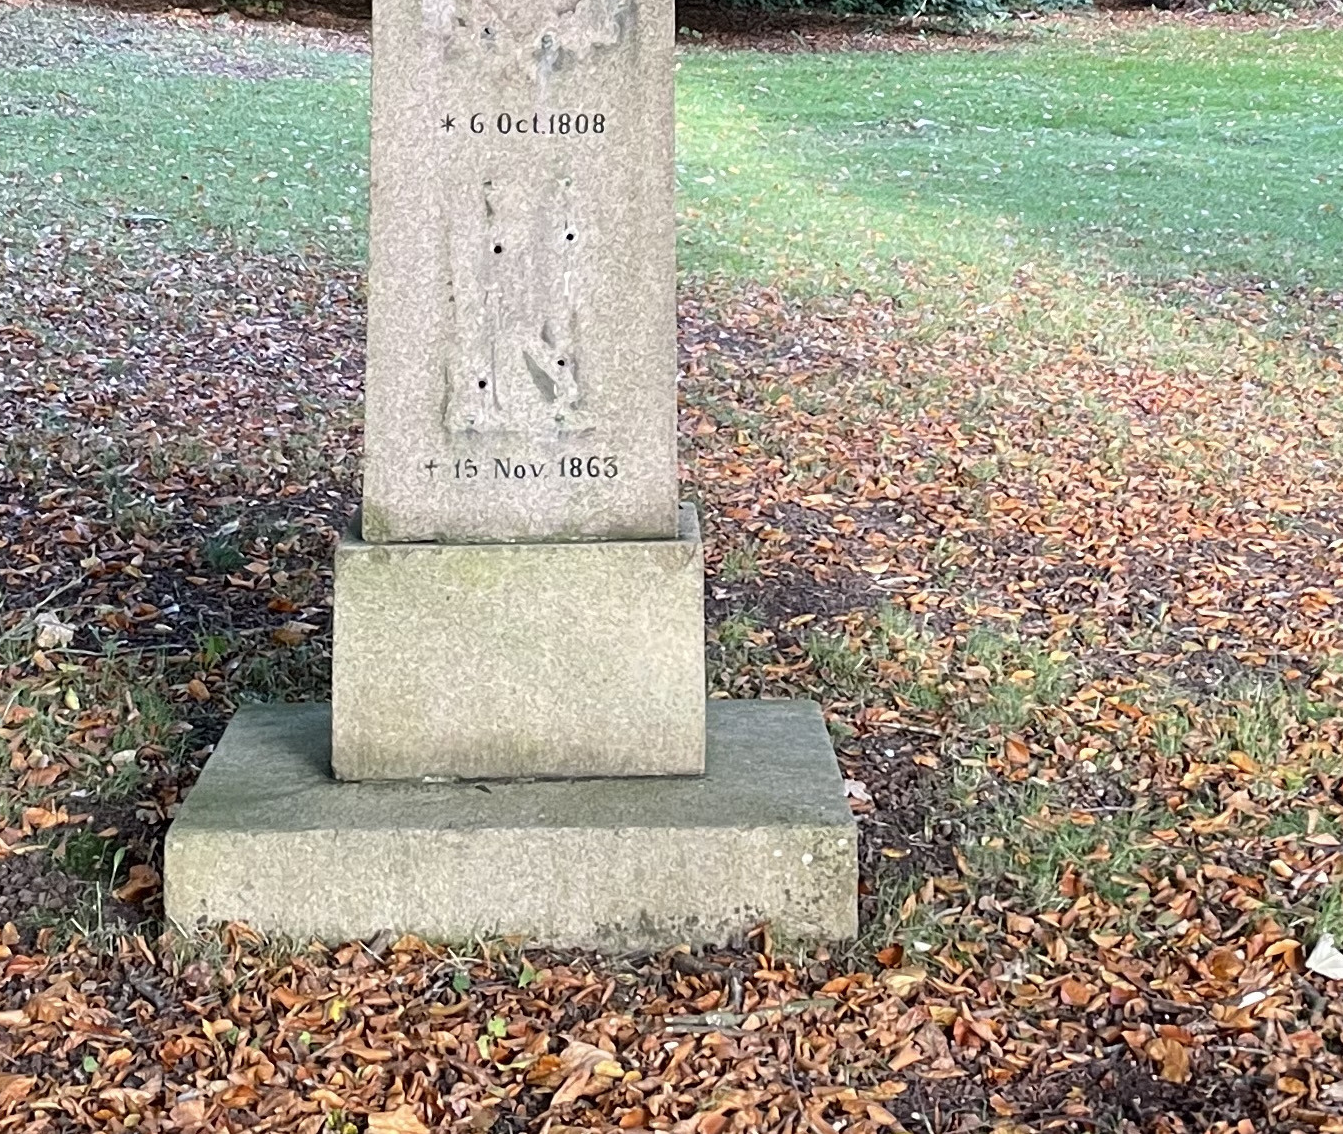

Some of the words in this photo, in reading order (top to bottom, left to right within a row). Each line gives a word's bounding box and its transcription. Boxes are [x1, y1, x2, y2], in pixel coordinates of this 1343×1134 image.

[469, 111, 485, 135] 6
[453, 456, 479, 480] 15
[558, 455, 619, 480] 1863
